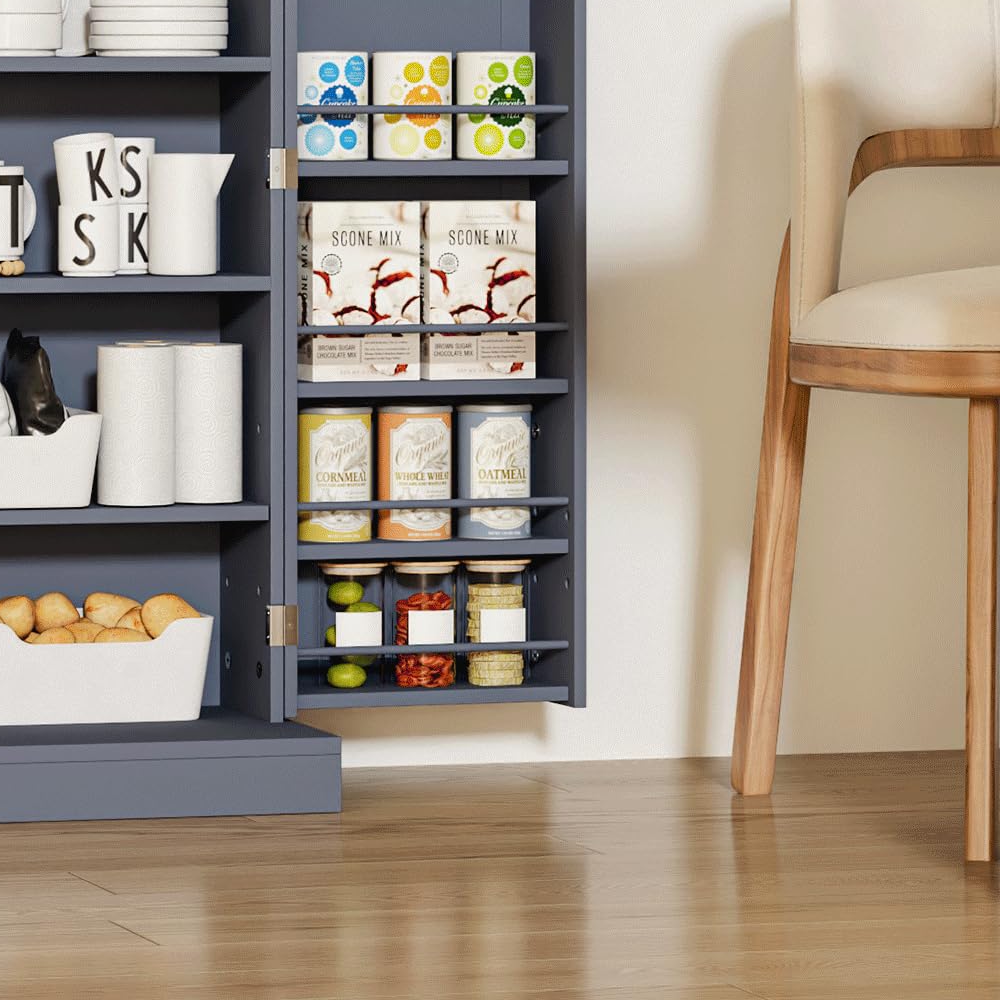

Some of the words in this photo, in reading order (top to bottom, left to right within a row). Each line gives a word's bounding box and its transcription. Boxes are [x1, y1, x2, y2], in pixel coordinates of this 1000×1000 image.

[86, 148, 113, 201] K
[120, 145, 141, 198] S
[72, 213, 96, 266] S
[128, 212, 148, 263] K
[331, 230, 373, 246] SCONE
[379, 230, 402, 246] MIX
[448, 229, 489, 245] SCONE
[495, 229, 518, 245] MIX
[316, 472, 367, 482] CORNMEAL
[395, 472, 425, 481] WHOLE
[478, 469, 527, 479] OATMEAL
